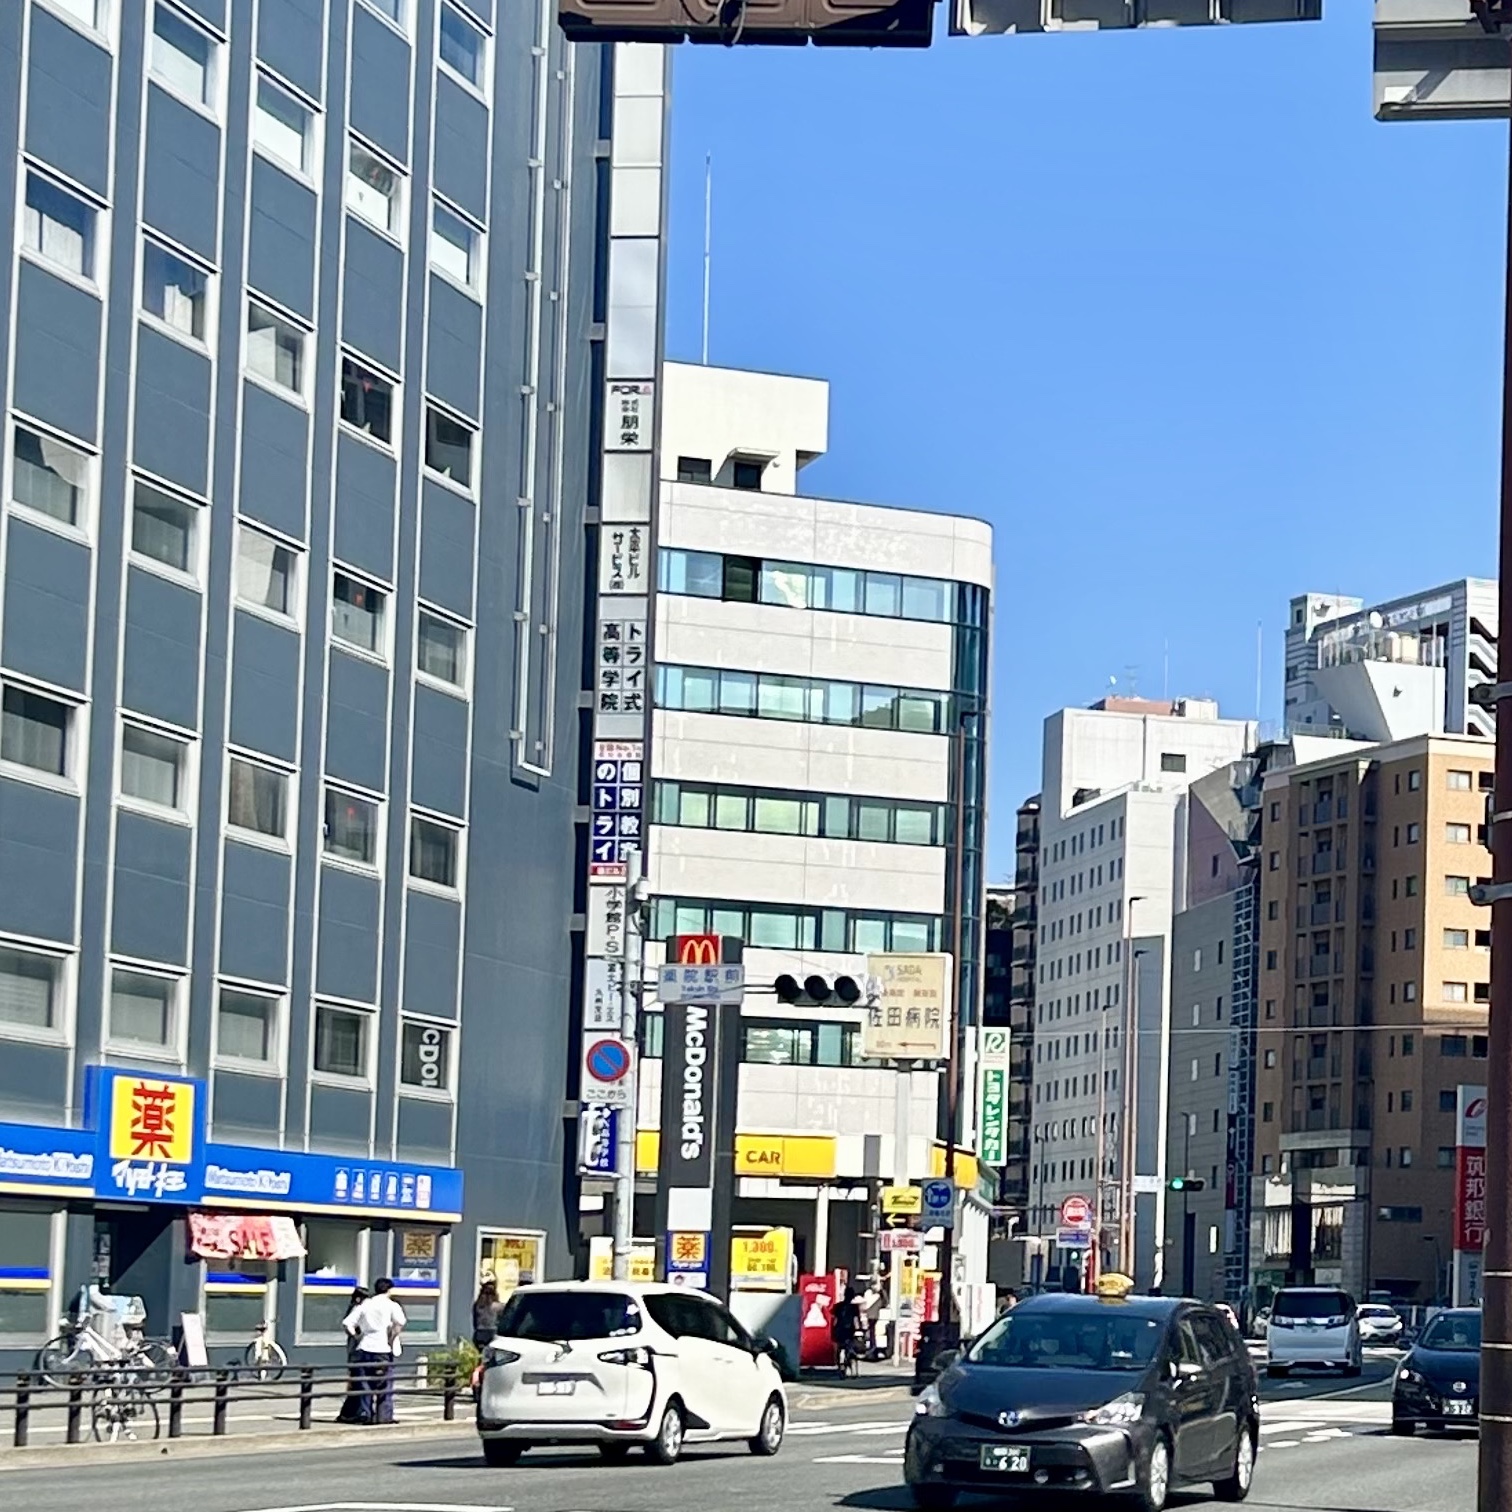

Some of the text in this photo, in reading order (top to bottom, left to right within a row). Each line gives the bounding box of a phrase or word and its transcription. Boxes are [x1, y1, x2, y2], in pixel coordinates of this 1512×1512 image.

[620, 415, 639, 446] 朋栄
[601, 623, 621, 711] 高等学院
[623, 623, 642, 711] トライ式
[595, 763, 617, 861] のトライ
[868, 1006, 940, 1029] 佐田病院
[130, 1081, 176, 1159] 薬
[681, 1005, 707, 1160] McDonald's
[984, 1070, 1001, 1161] トヨタレンタカー
[746, 1149, 781, 1165] CAR
[229, 1230, 274, 1257] SALE
